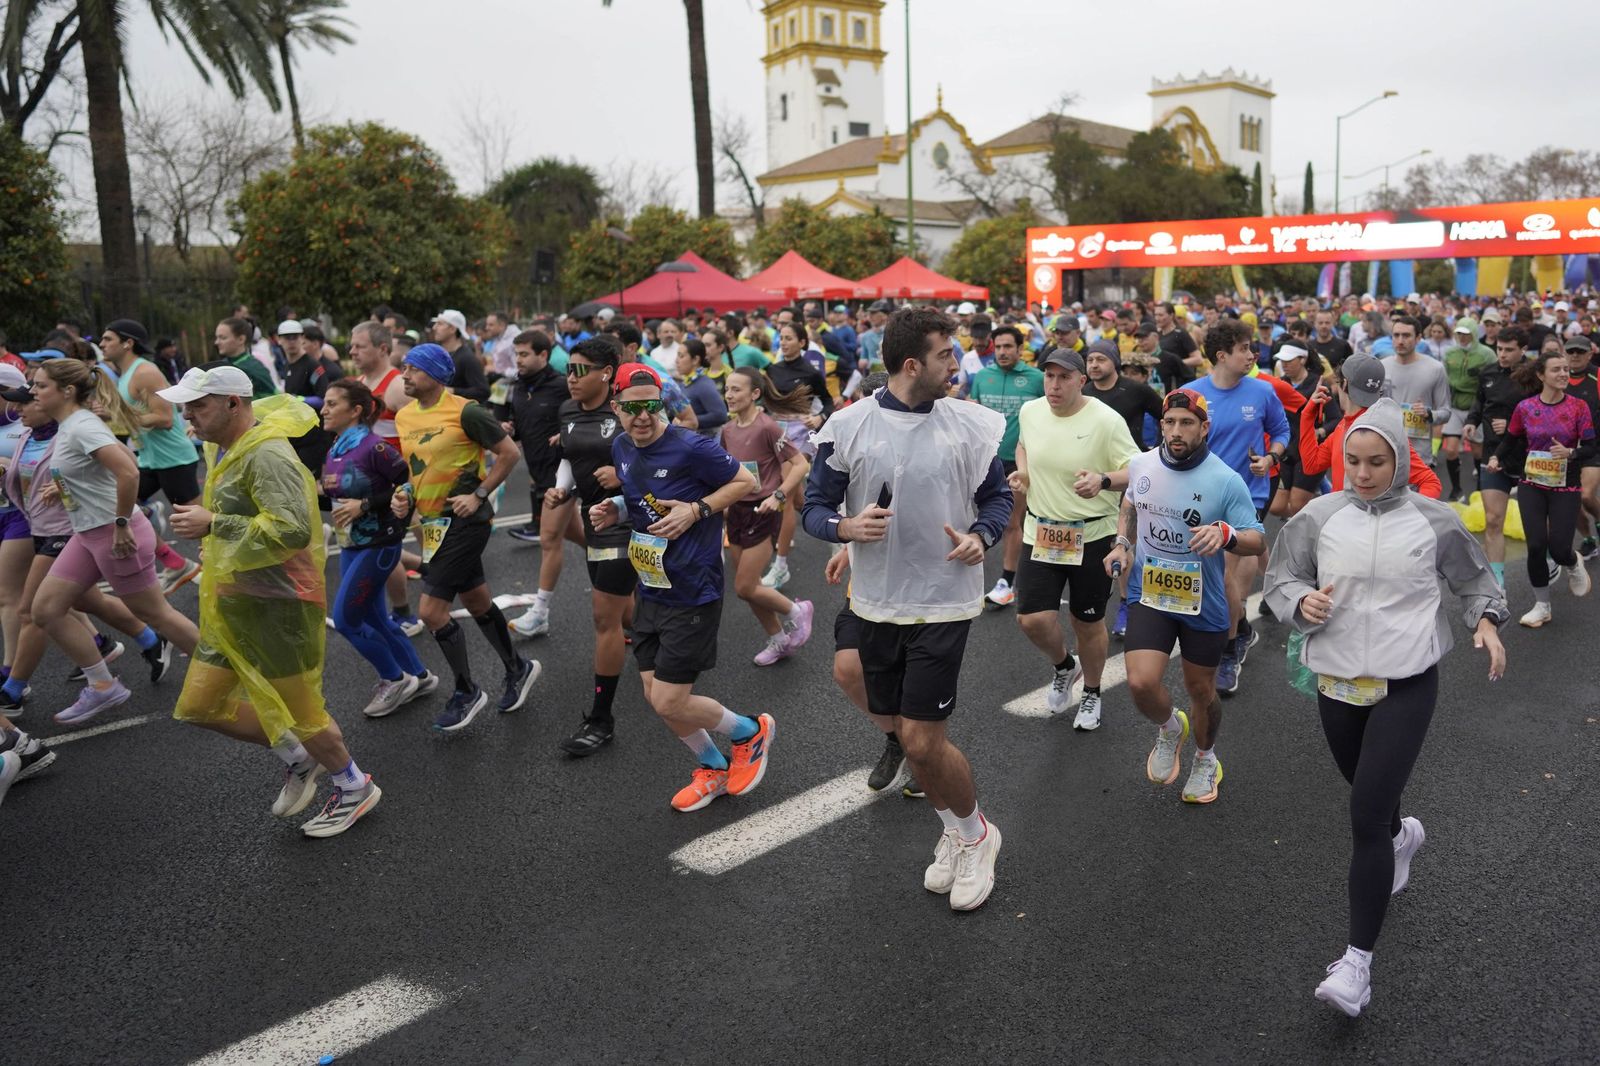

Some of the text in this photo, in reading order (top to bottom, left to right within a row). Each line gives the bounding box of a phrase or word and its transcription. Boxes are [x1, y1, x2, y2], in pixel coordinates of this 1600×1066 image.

[1042, 527, 1072, 545] 7884
[630, 545, 657, 567] 14886
[1147, 569, 1193, 591] 14659
